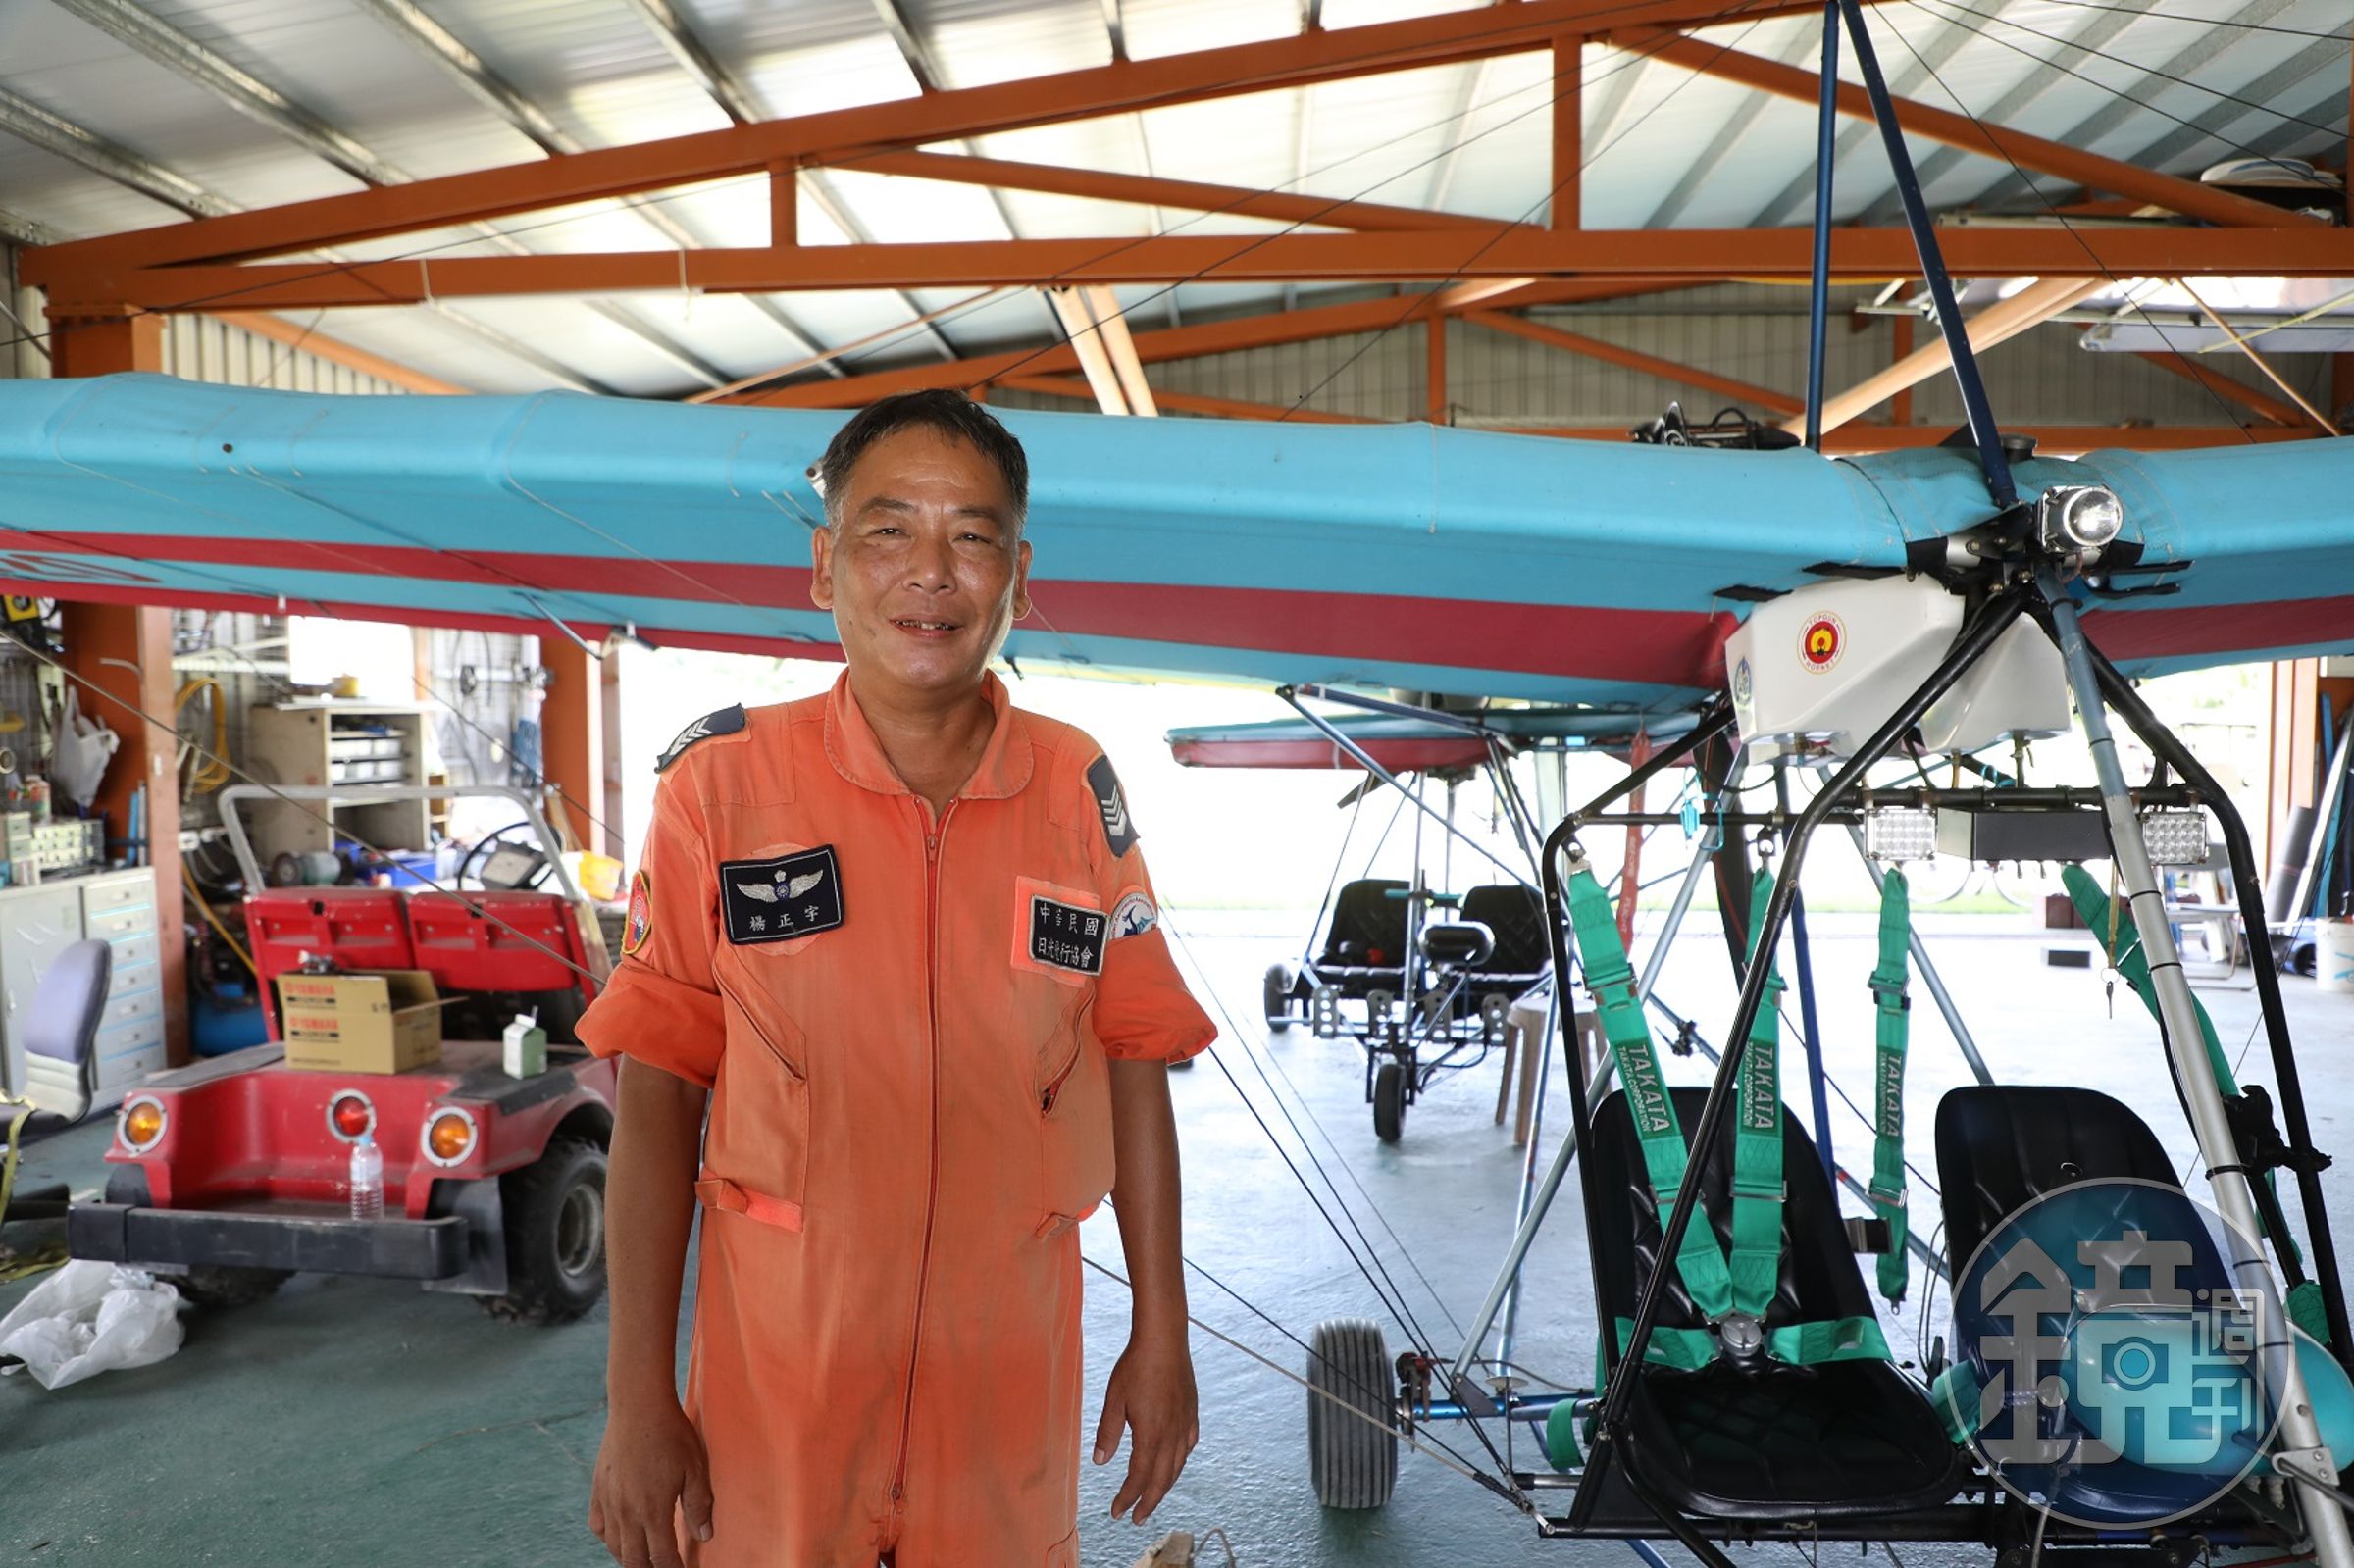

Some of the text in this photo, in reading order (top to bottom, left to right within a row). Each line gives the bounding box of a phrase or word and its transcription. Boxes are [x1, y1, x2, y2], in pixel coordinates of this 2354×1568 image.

[1617, 1046, 1653, 1133] TAKATA CORPORATION
[1628, 1044, 1671, 1133] TAKATA
[1754, 1046, 1775, 1129] TAKATA
[1886, 1055, 1902, 1138] TAKATA
